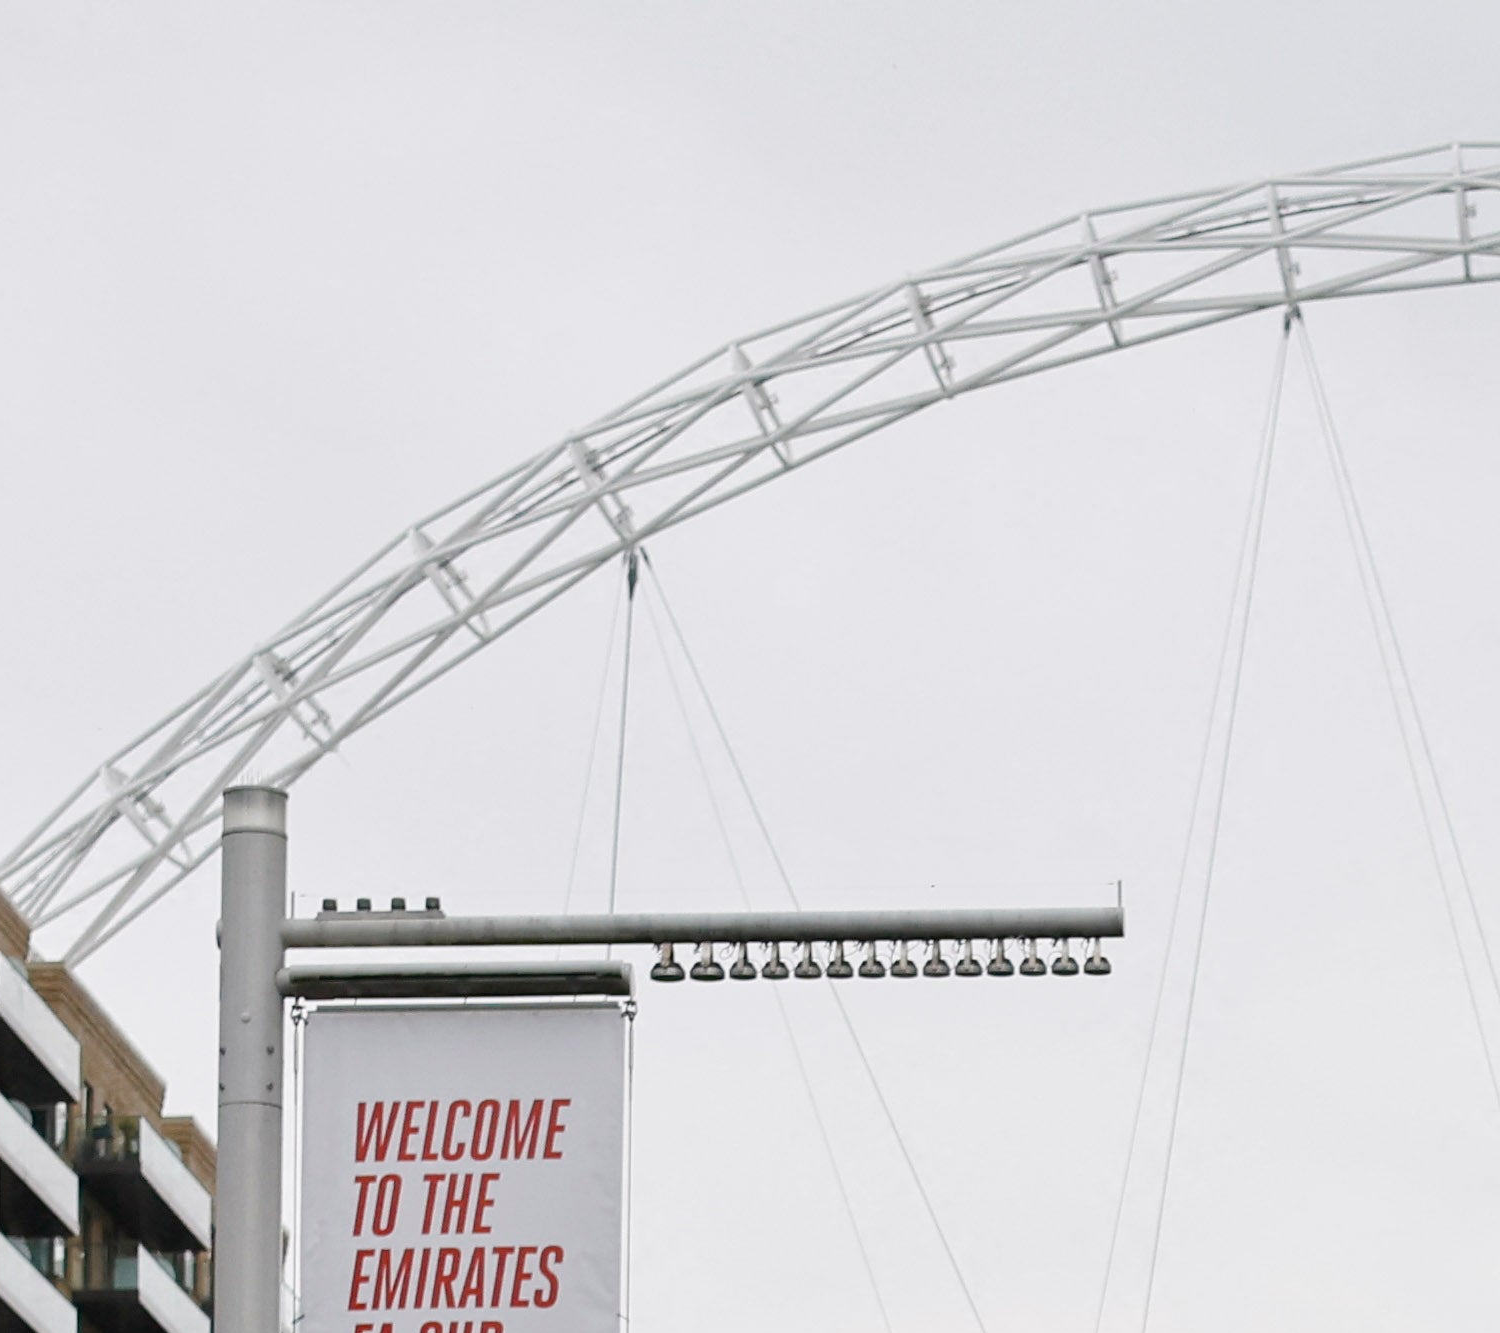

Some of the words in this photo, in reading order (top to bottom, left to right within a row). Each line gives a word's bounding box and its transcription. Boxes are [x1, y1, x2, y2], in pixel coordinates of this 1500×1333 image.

[355, 1098, 571, 1162] WELCOME
[353, 1174, 403, 1236] TO
[421, 1173, 500, 1234] THE
[348, 1246, 564, 1311] EMIRATES
